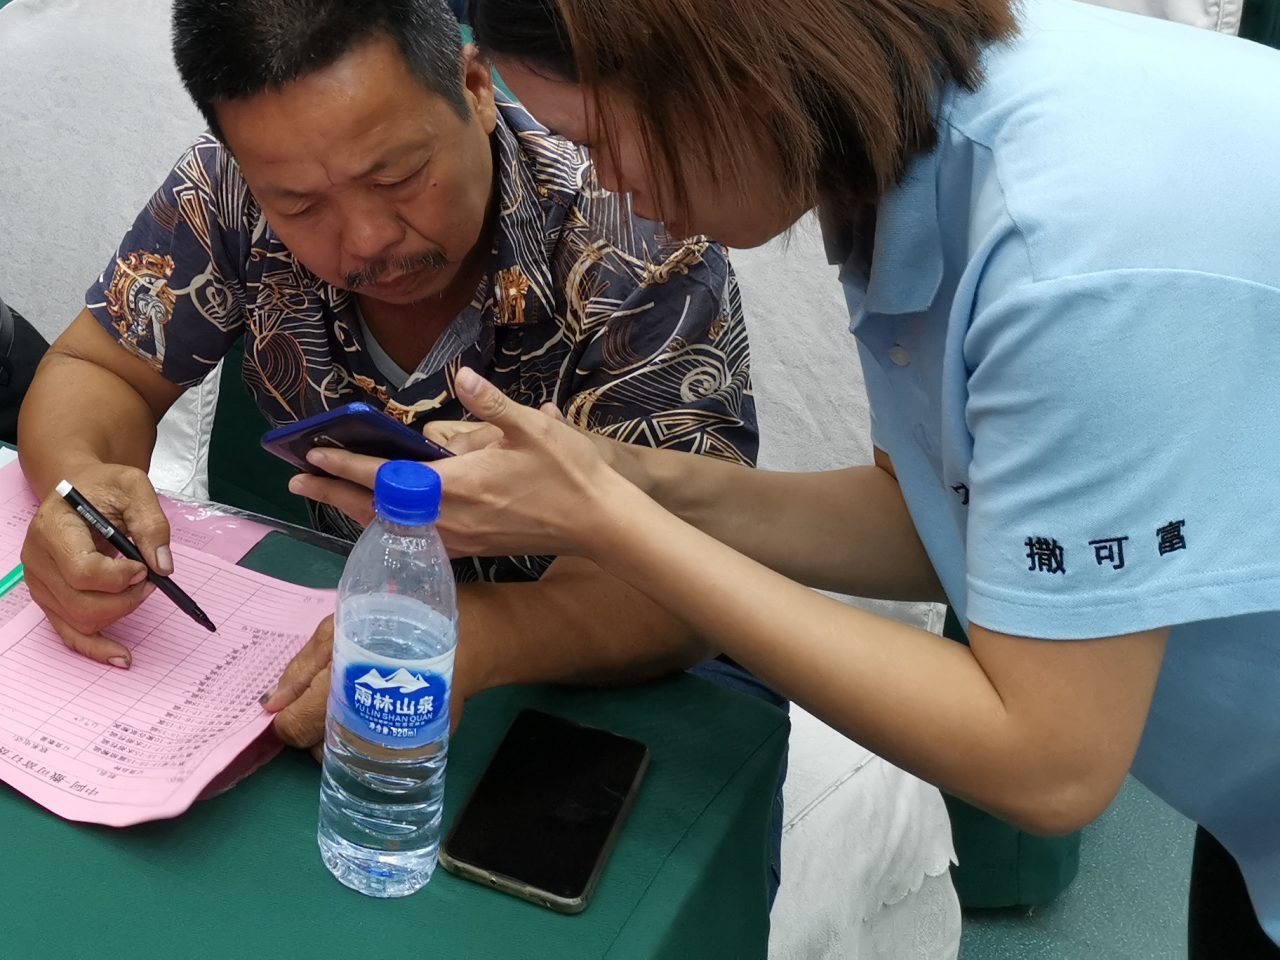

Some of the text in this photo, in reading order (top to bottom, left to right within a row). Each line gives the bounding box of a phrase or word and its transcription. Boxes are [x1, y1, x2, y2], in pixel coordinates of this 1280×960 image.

[1024, 518, 1187, 575] 撒可富
[354, 684, 434, 715] 雨林山泉
[354, 702, 365, 713] YU
[366, 708, 380, 719] LIN
[382, 712, 408, 722] SHAN
[410, 712, 433, 723] QUAN
